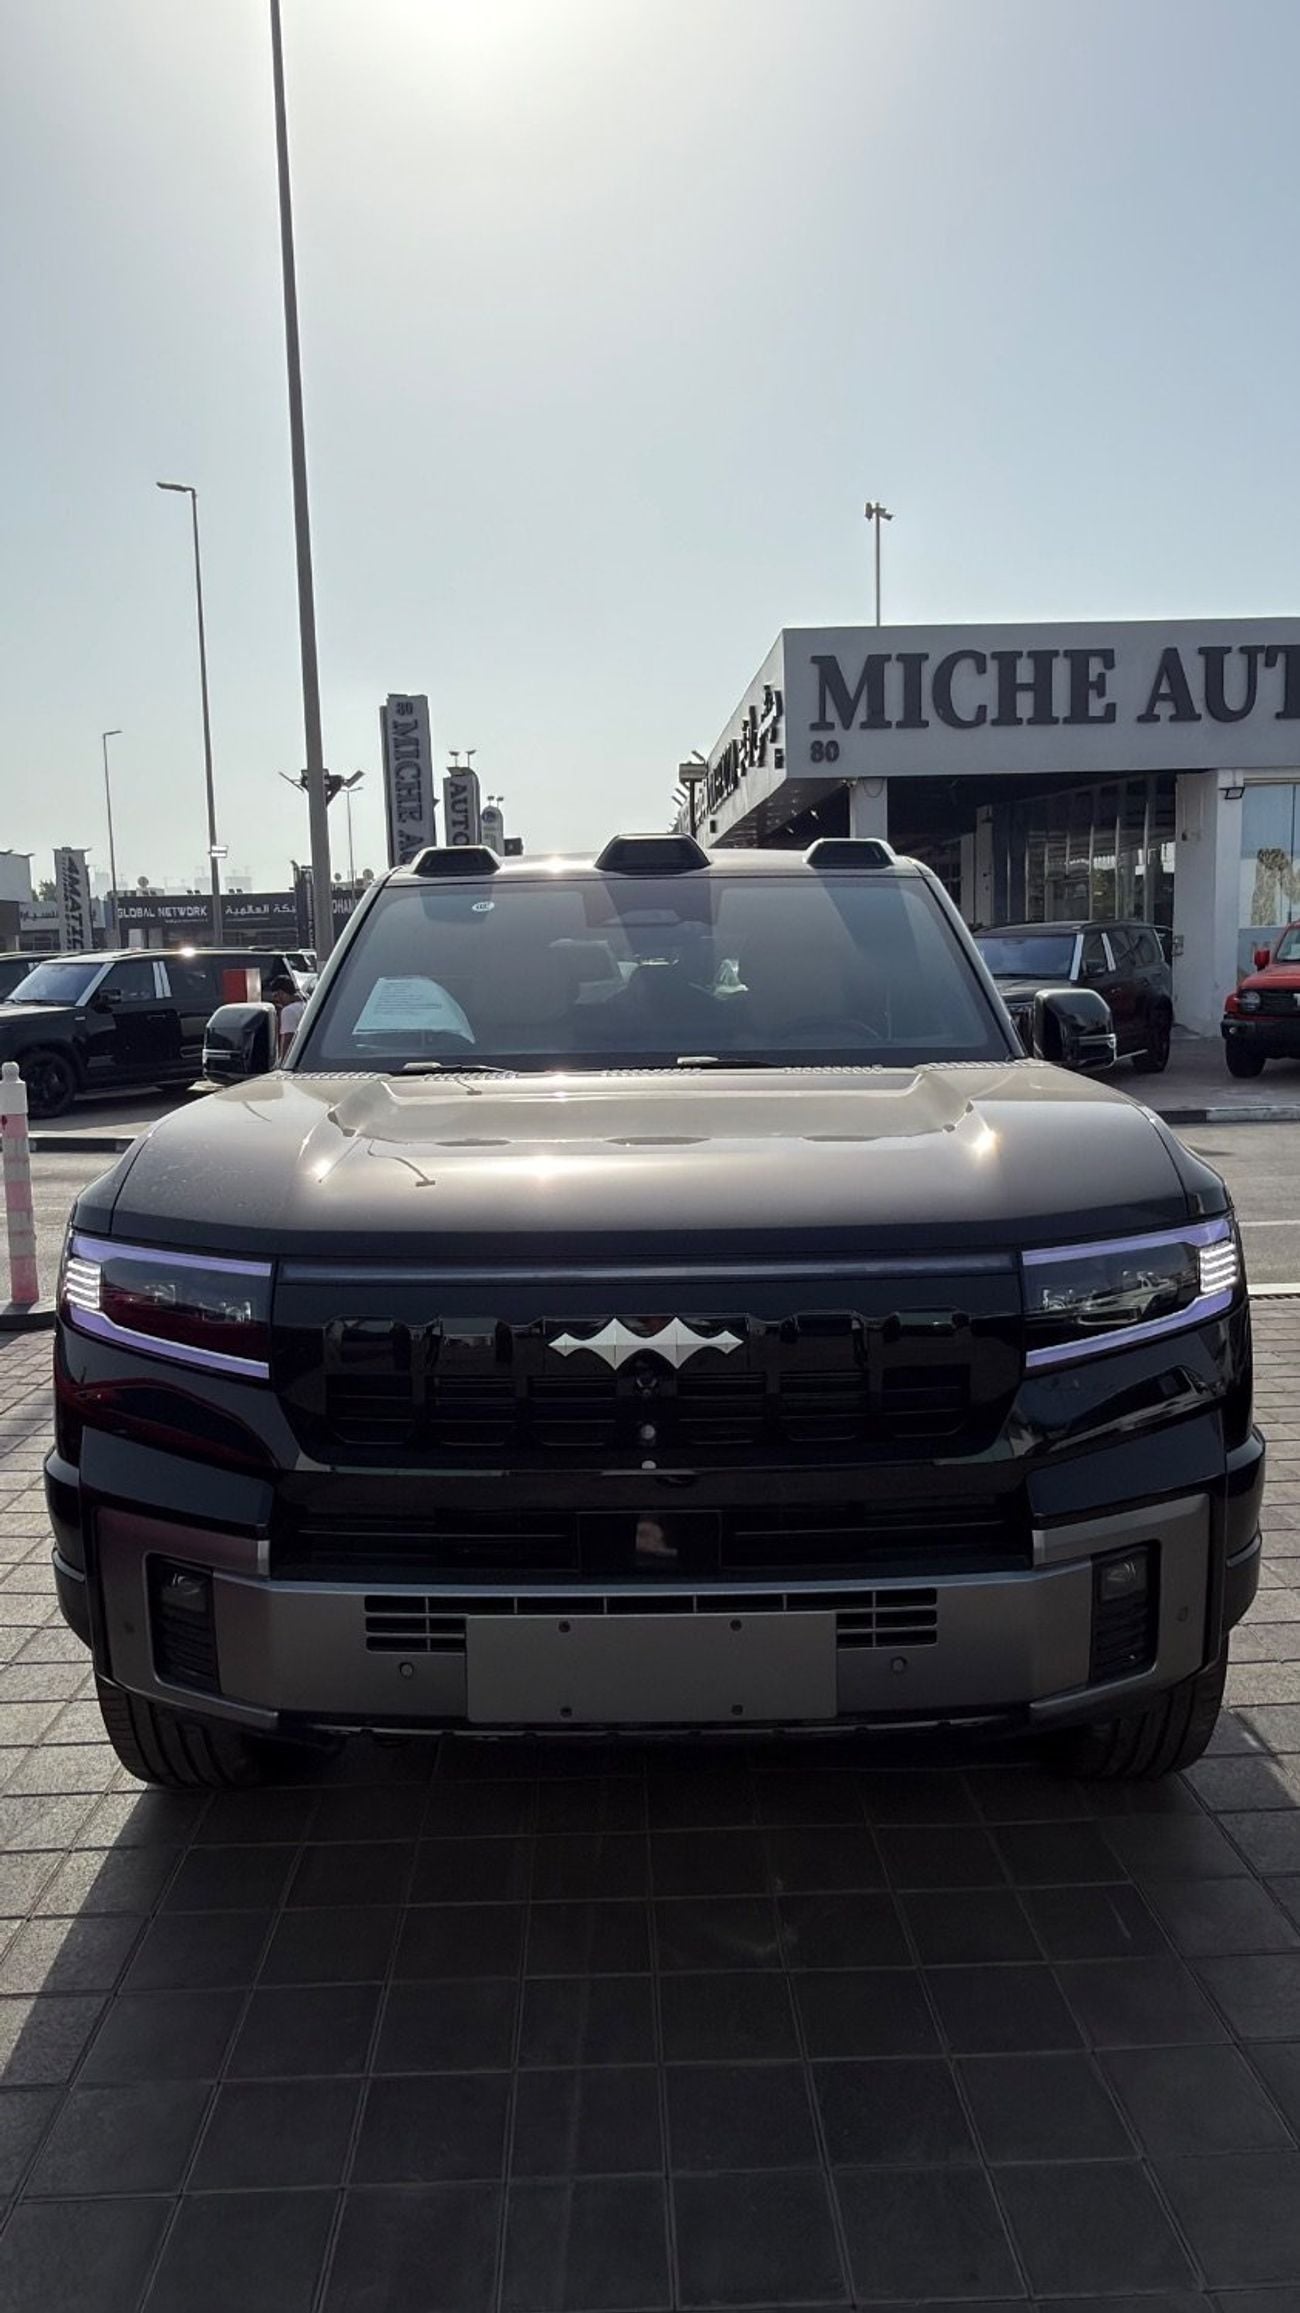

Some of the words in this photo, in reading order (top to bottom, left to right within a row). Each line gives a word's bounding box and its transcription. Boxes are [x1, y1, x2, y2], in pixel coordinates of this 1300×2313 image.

[810, 648, 1116, 732] MICHE
[392, 719, 423, 823] MICHE
[810, 740, 840, 763] 80
[117, 907, 155, 919] GLOBAL
[158, 905, 208, 918] NETWORK
